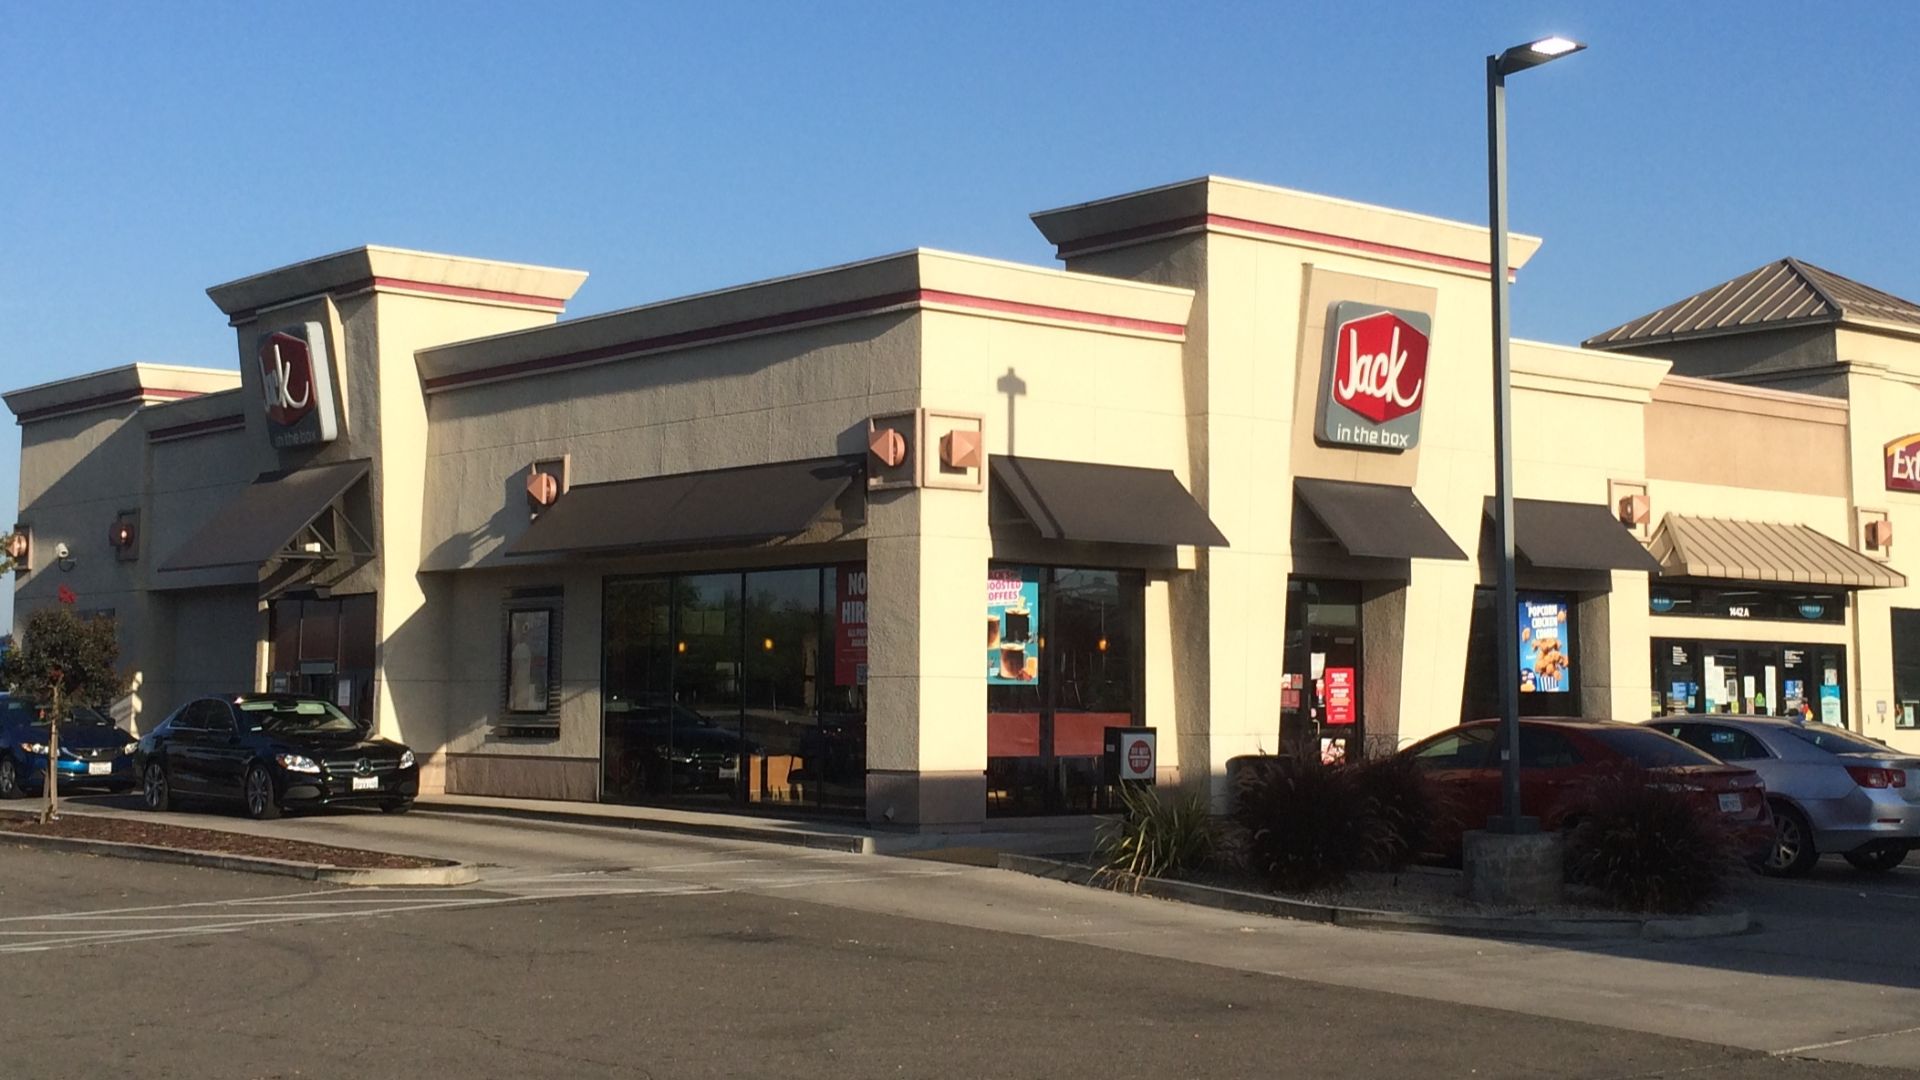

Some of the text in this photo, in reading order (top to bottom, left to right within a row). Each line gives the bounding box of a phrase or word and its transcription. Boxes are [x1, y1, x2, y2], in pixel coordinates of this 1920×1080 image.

[1338, 326, 1422, 408] Jack
[1336, 423, 1410, 447] in the box
[848, 572, 867, 596] NO
[987, 581, 1021, 591] OOSTED
[988, 591, 1018, 601] OFFEES
